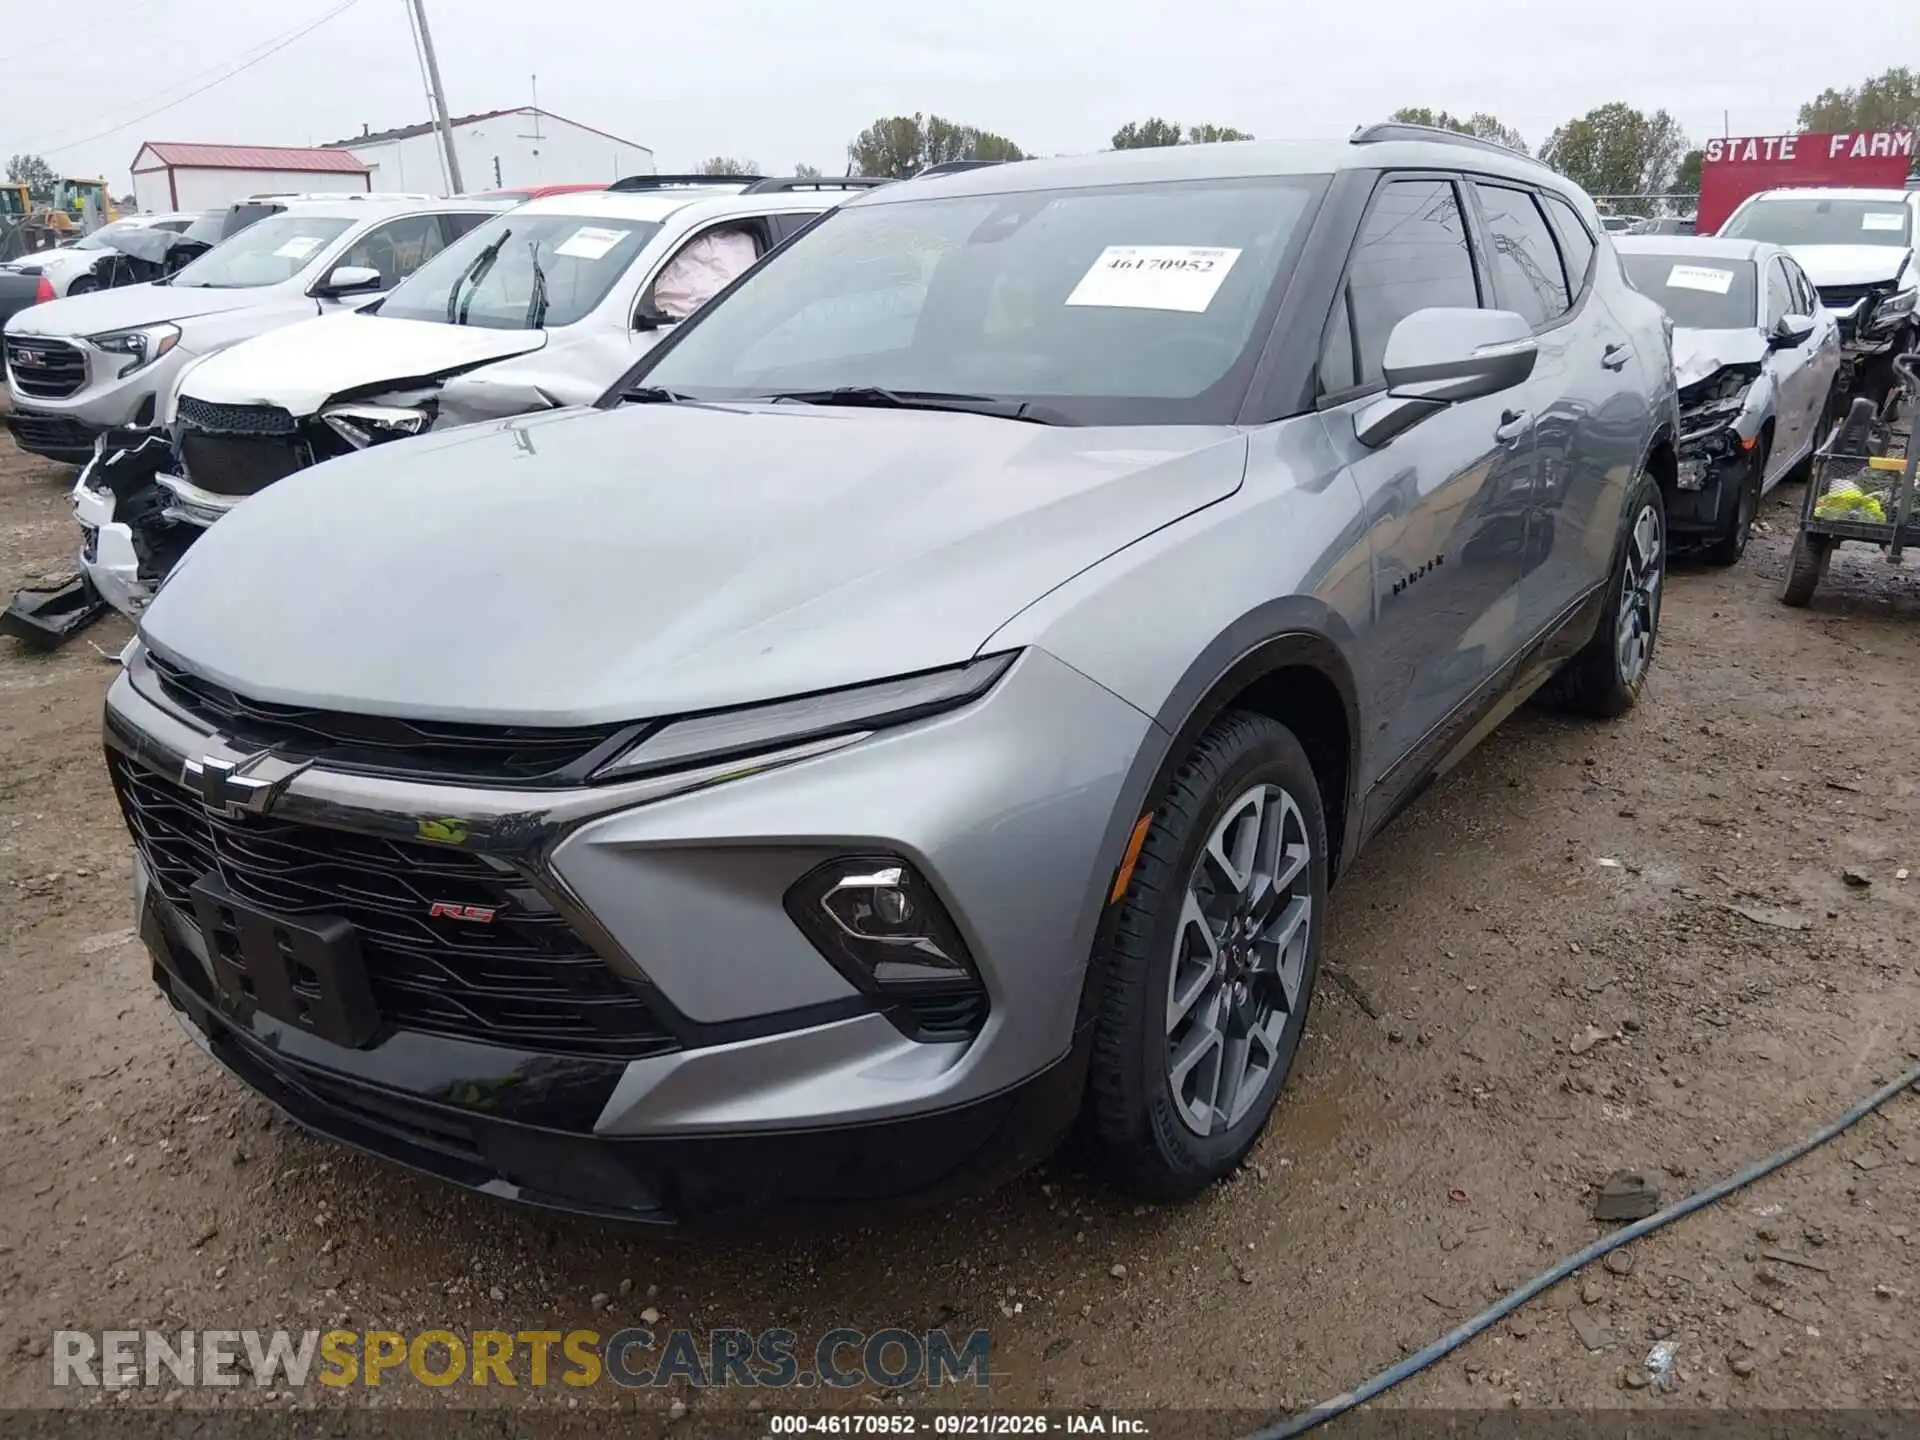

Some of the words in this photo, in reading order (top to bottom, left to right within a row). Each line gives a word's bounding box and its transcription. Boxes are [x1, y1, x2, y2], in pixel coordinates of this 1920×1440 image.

[1706, 137, 1799, 162] STATE
[1828, 131, 1914, 159] FARM
[1107, 258, 1215, 273] 46170952
[429, 902, 496, 923] RS
